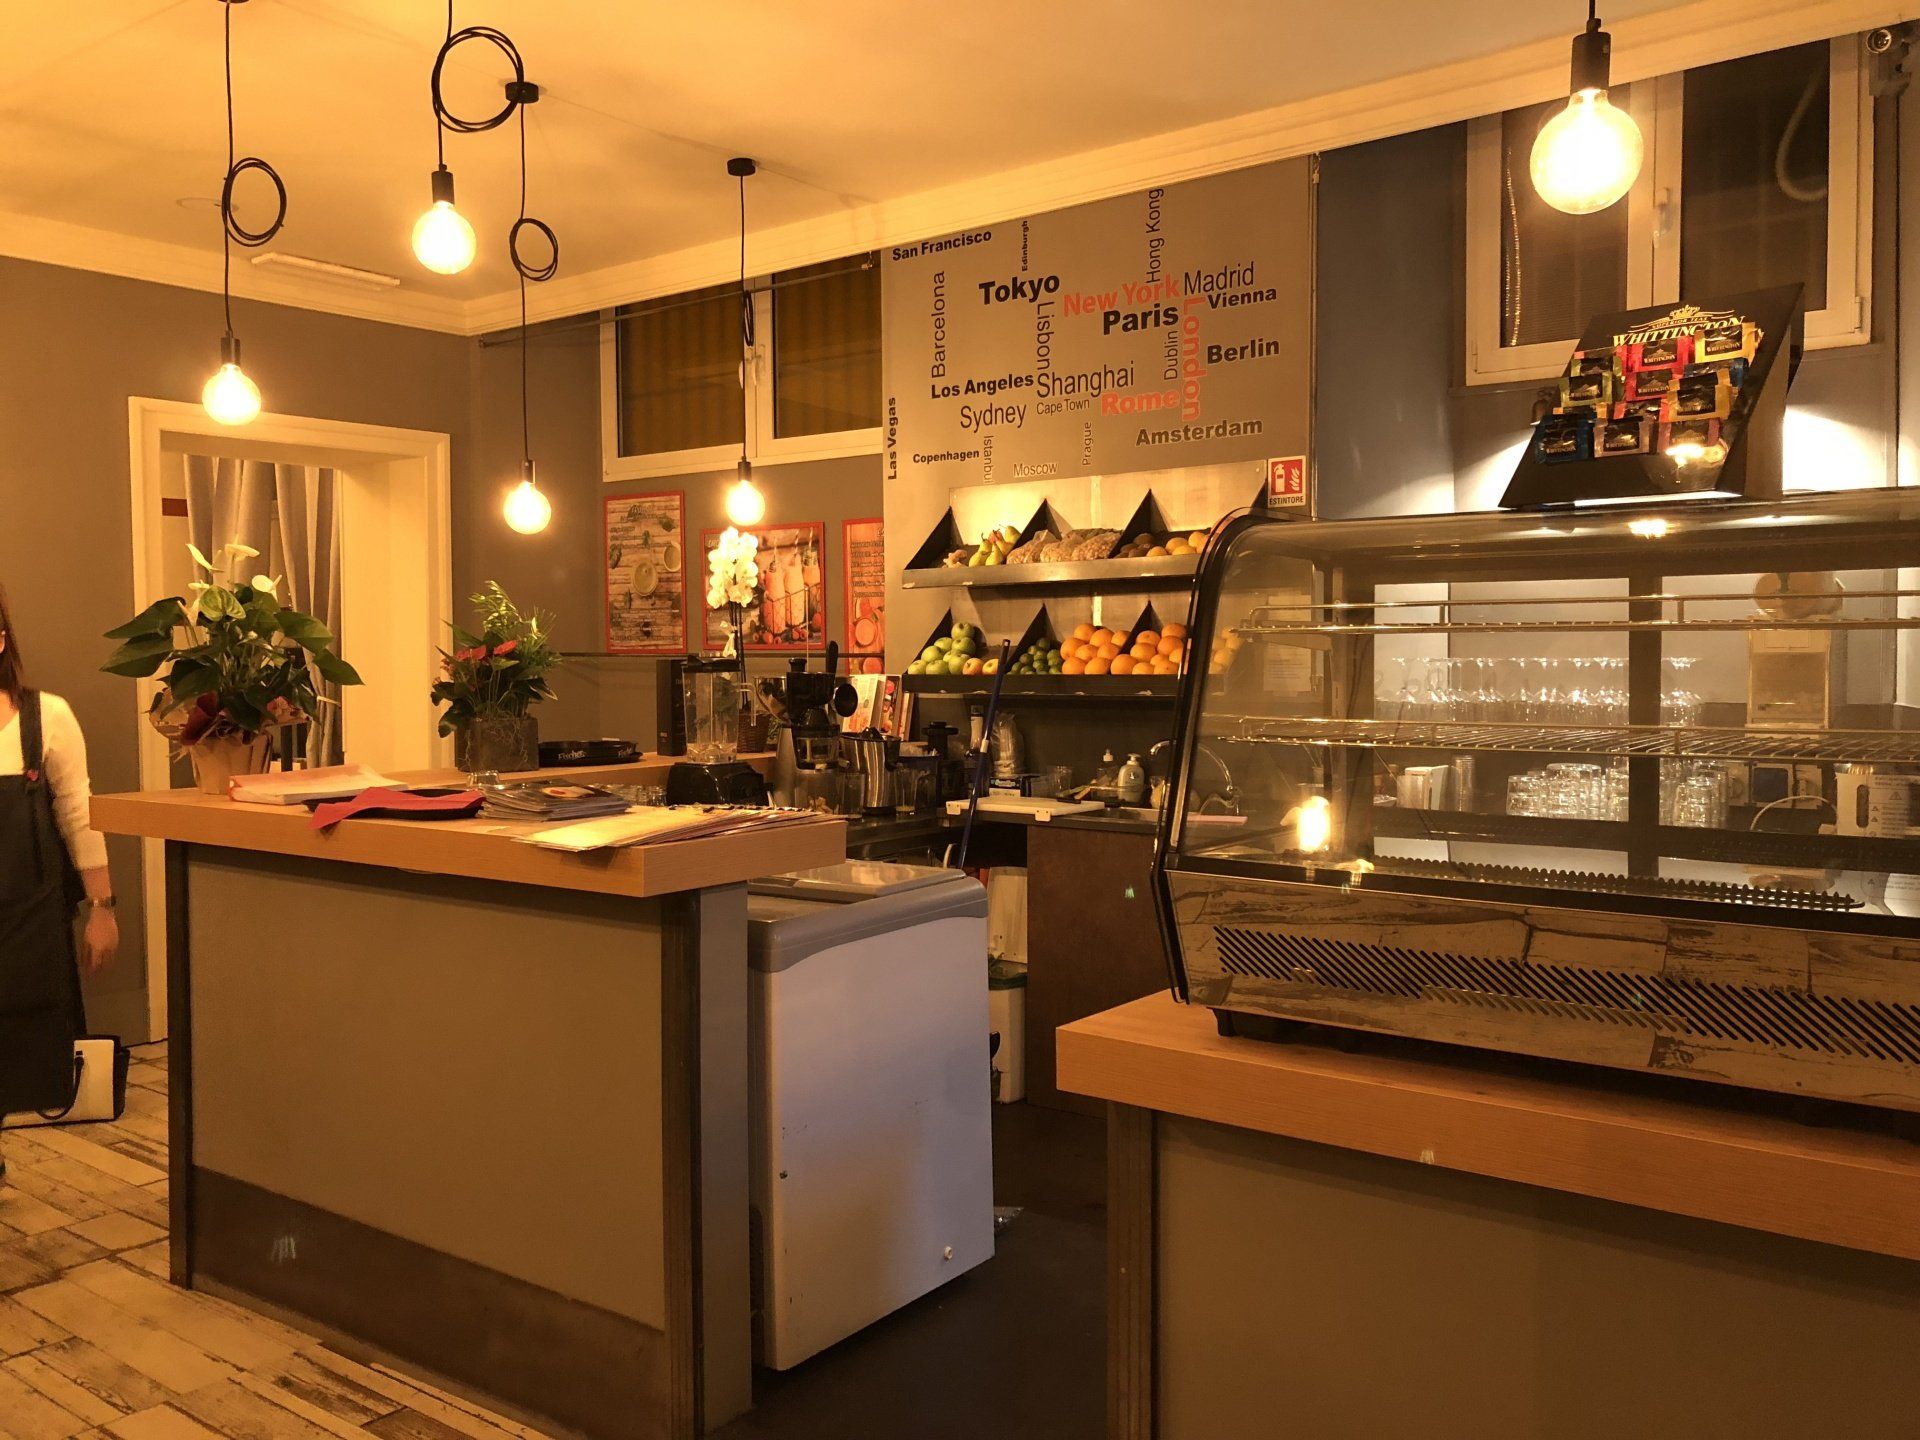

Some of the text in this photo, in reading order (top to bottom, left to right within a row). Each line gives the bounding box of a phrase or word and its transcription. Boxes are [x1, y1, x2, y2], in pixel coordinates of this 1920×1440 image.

[892, 231, 992, 261] San Francisco
[1021, 220, 1030, 272] Edinburgh
[1146, 188, 1165, 284] Hong Kong
[978, 275, 1060, 305] Tokyo
[1184, 261, 1255, 296] Madrid
[1063, 273, 1181, 318] New York
[1207, 288, 1277, 309] Vienna
[931, 271, 946, 379] Barcelona
[1103, 303, 1179, 335] Paris
[1036, 301, 1055, 371] Lisbon
[1207, 338, 1280, 364] Berlin
[1164, 330, 1178, 380] Dublin
[1182, 296, 1207, 422] London
[931, 374, 1034, 399] Los Angeles
[1036, 360, 1134, 398] Shanghai
[960, 402, 1027, 433] Sydney
[1036, 398, 1090, 417] Cape Town
[1100, 390, 1180, 417] Rome
[887, 397, 899, 480] Las Vegas
[1082, 422, 1094, 466] Prague
[1135, 419, 1263, 446] Amsterdam
[913, 450, 980, 465] Copenhagen
[983, 435, 995, 485] Istanbul
[1013, 463, 1058, 479] Moscow
[1269, 496, 1304, 505] ESTINTORE
